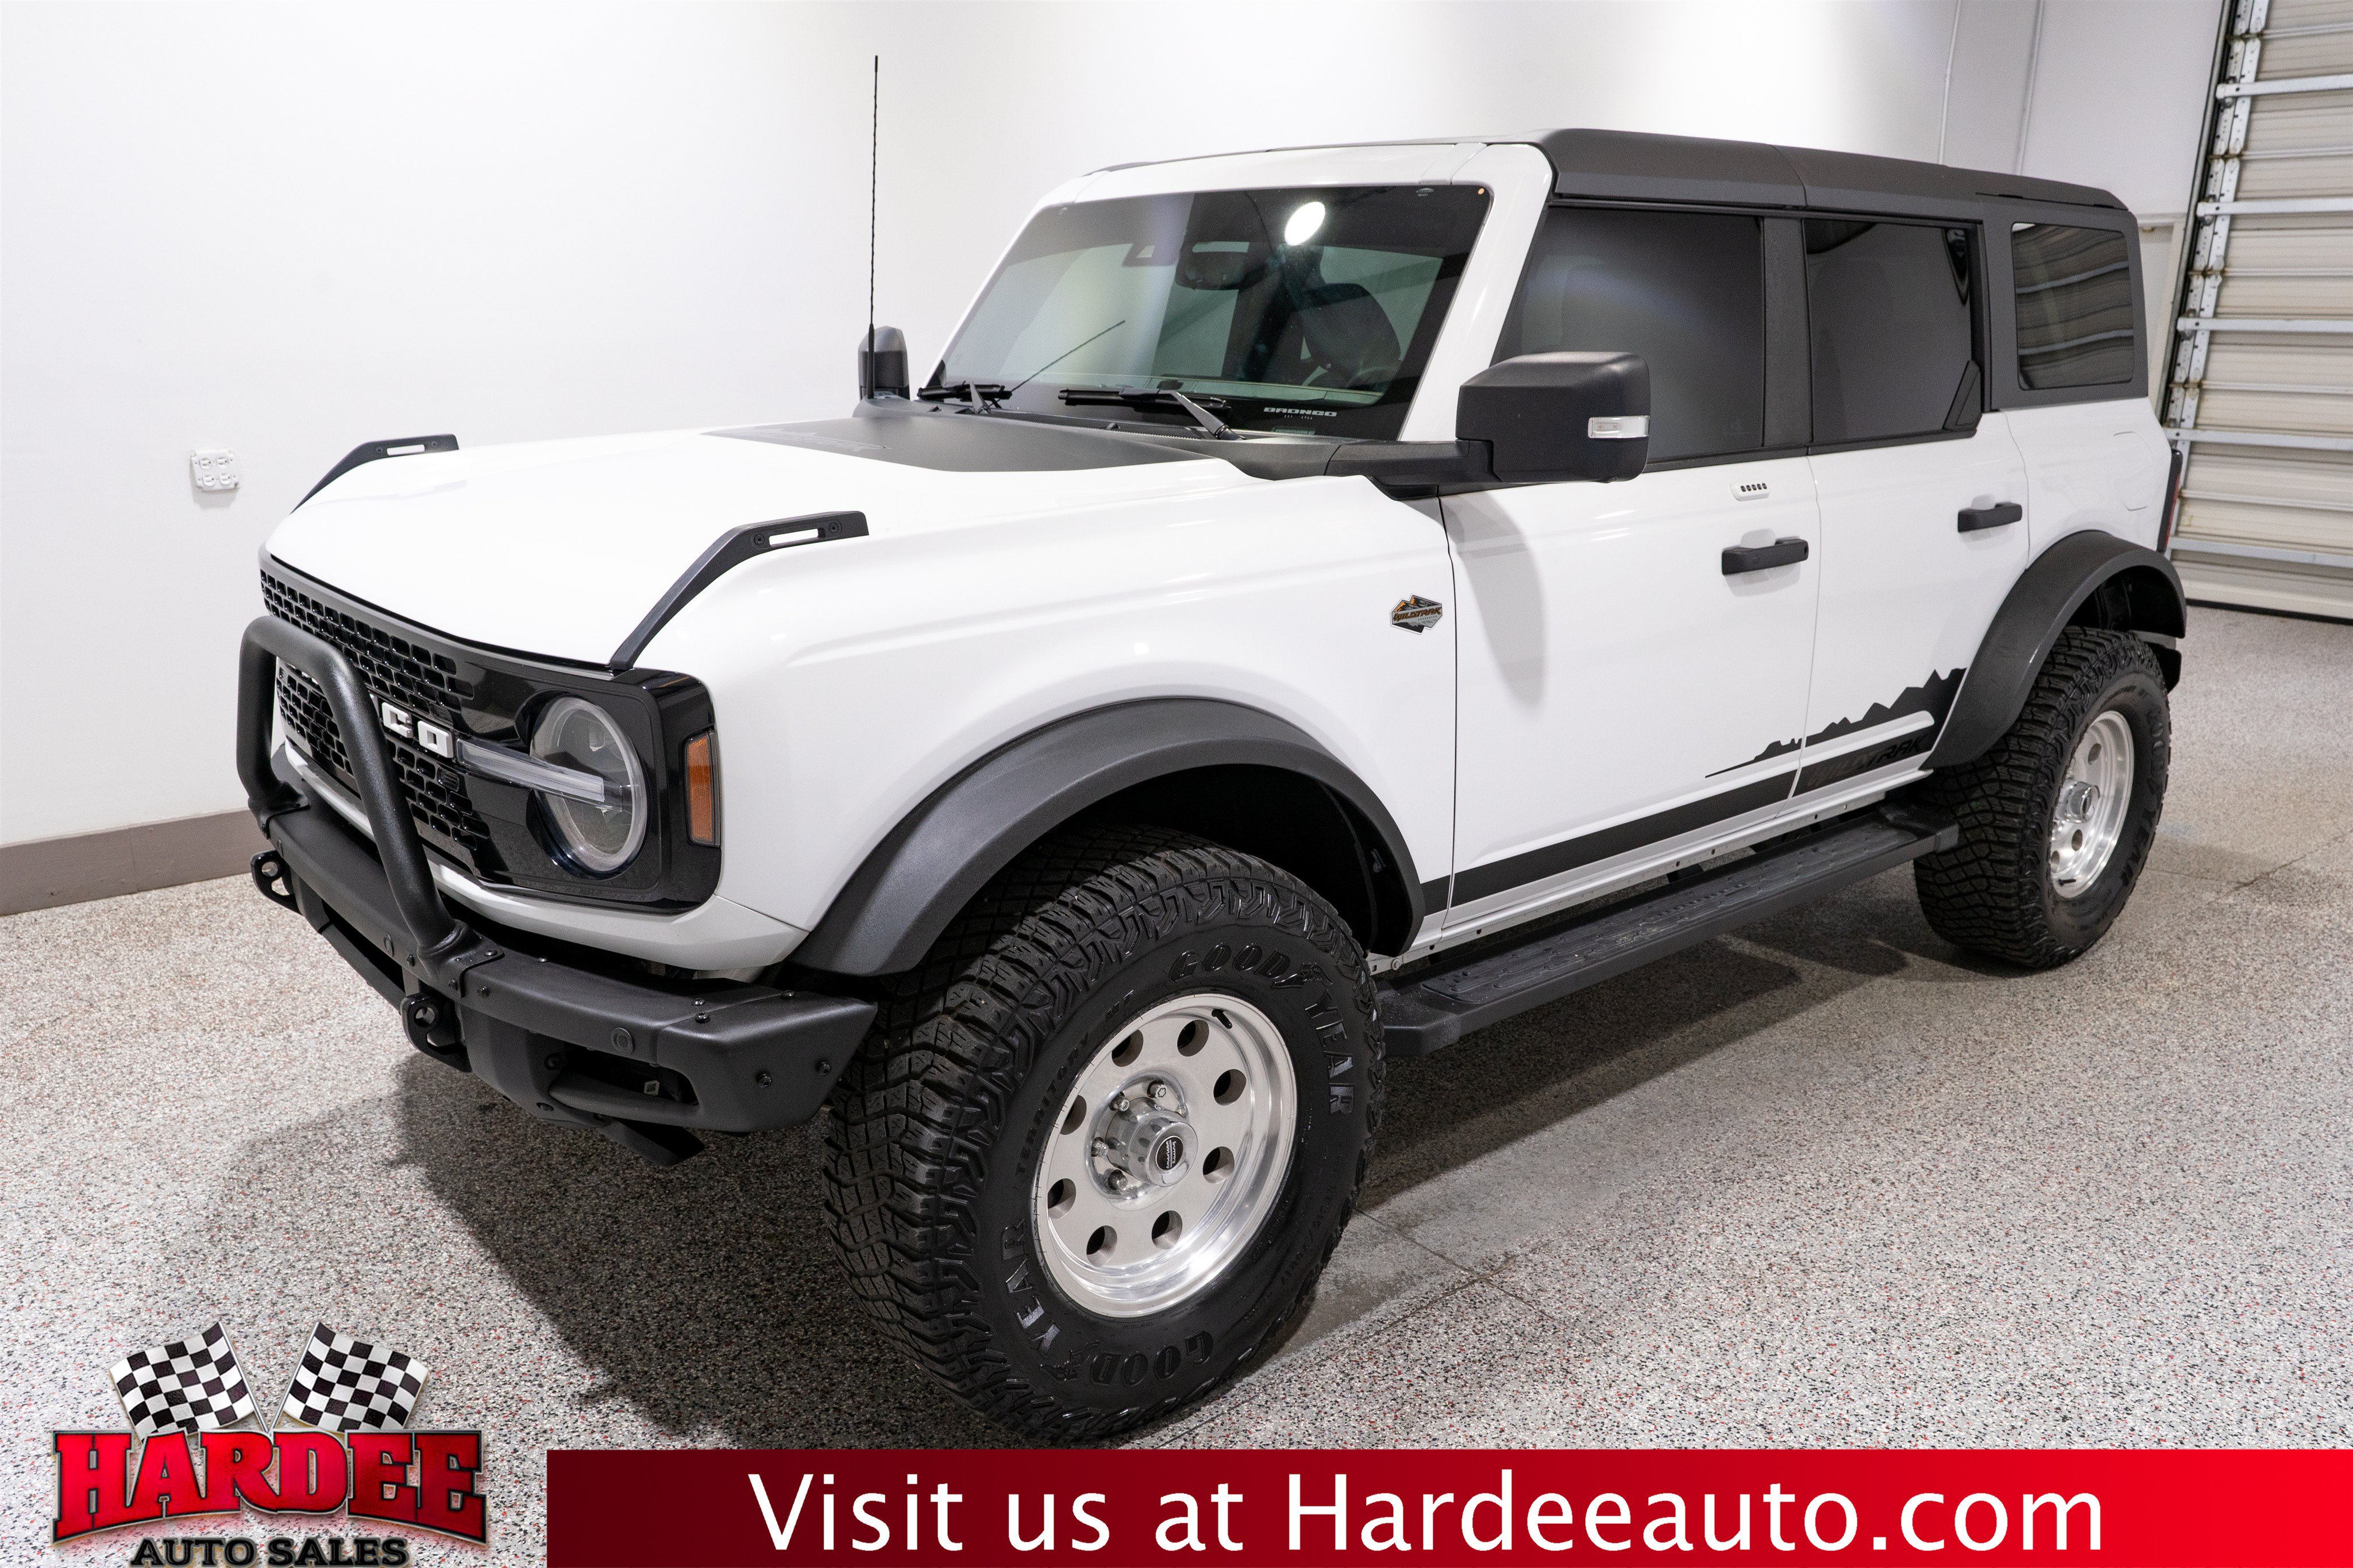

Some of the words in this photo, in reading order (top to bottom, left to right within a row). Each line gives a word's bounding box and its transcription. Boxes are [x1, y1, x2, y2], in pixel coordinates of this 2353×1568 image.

[1264, 407, 1337, 417] BRONCO
[1393, 607, 1441, 621] WILDTRAK
[1016, 1032, 1089, 1176] TERRITORY
